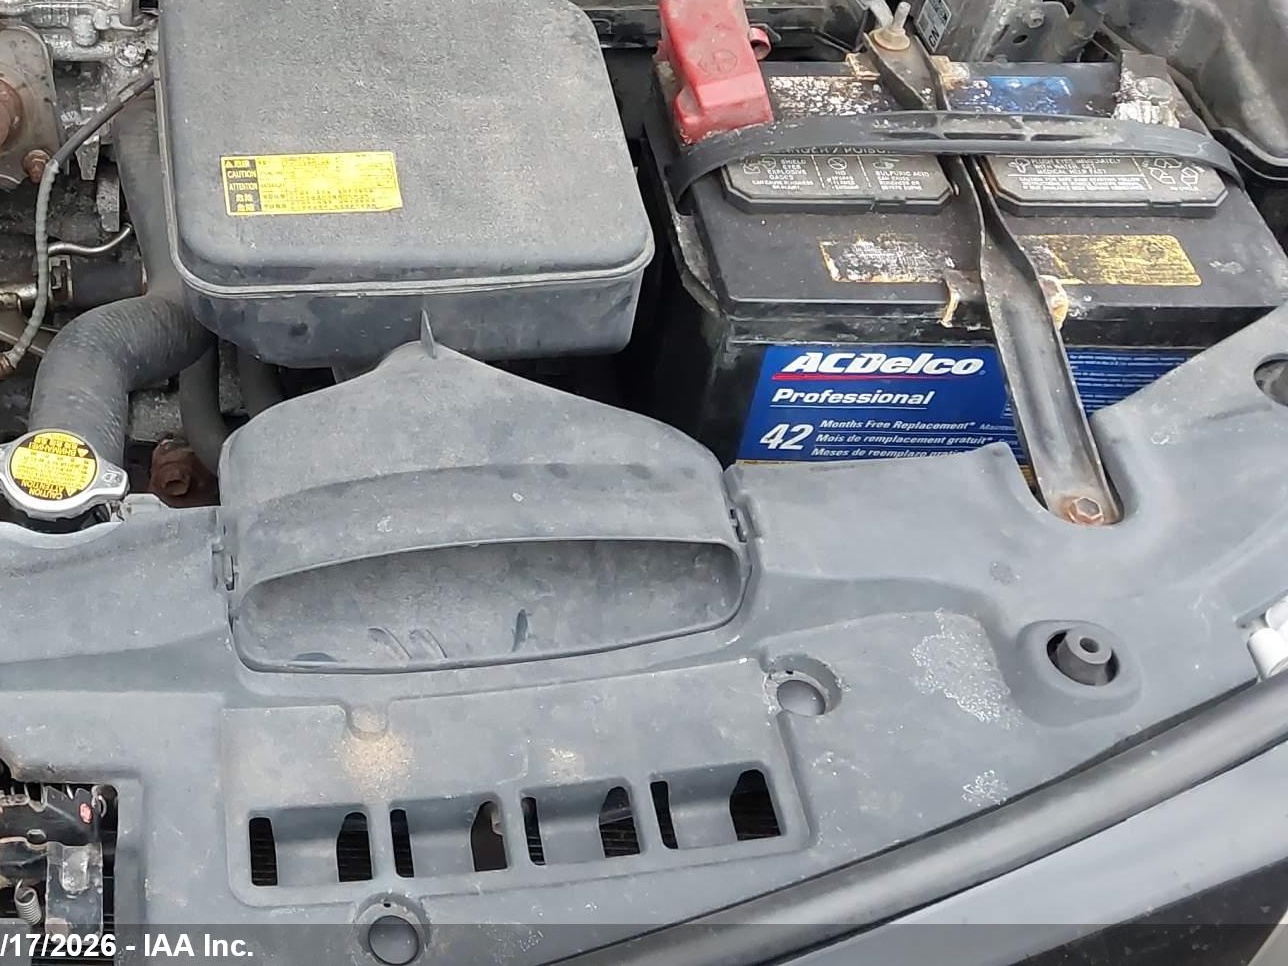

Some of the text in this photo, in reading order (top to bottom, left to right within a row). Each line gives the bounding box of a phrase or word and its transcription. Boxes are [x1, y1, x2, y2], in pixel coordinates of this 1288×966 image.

[781, 351, 984, 375] ACDelco
[771, 387, 935, 405] Professional
[819, 419, 863, 429] Months
[864, 419, 891, 429] Free
[759, 423, 815, 450] 42
[815, 434, 845, 443] Mois
[846, 434, 862, 443] de
[863, 435, 946, 445] remplacement
[811, 448, 850, 456] Meses
[851, 448, 867, 456] de
